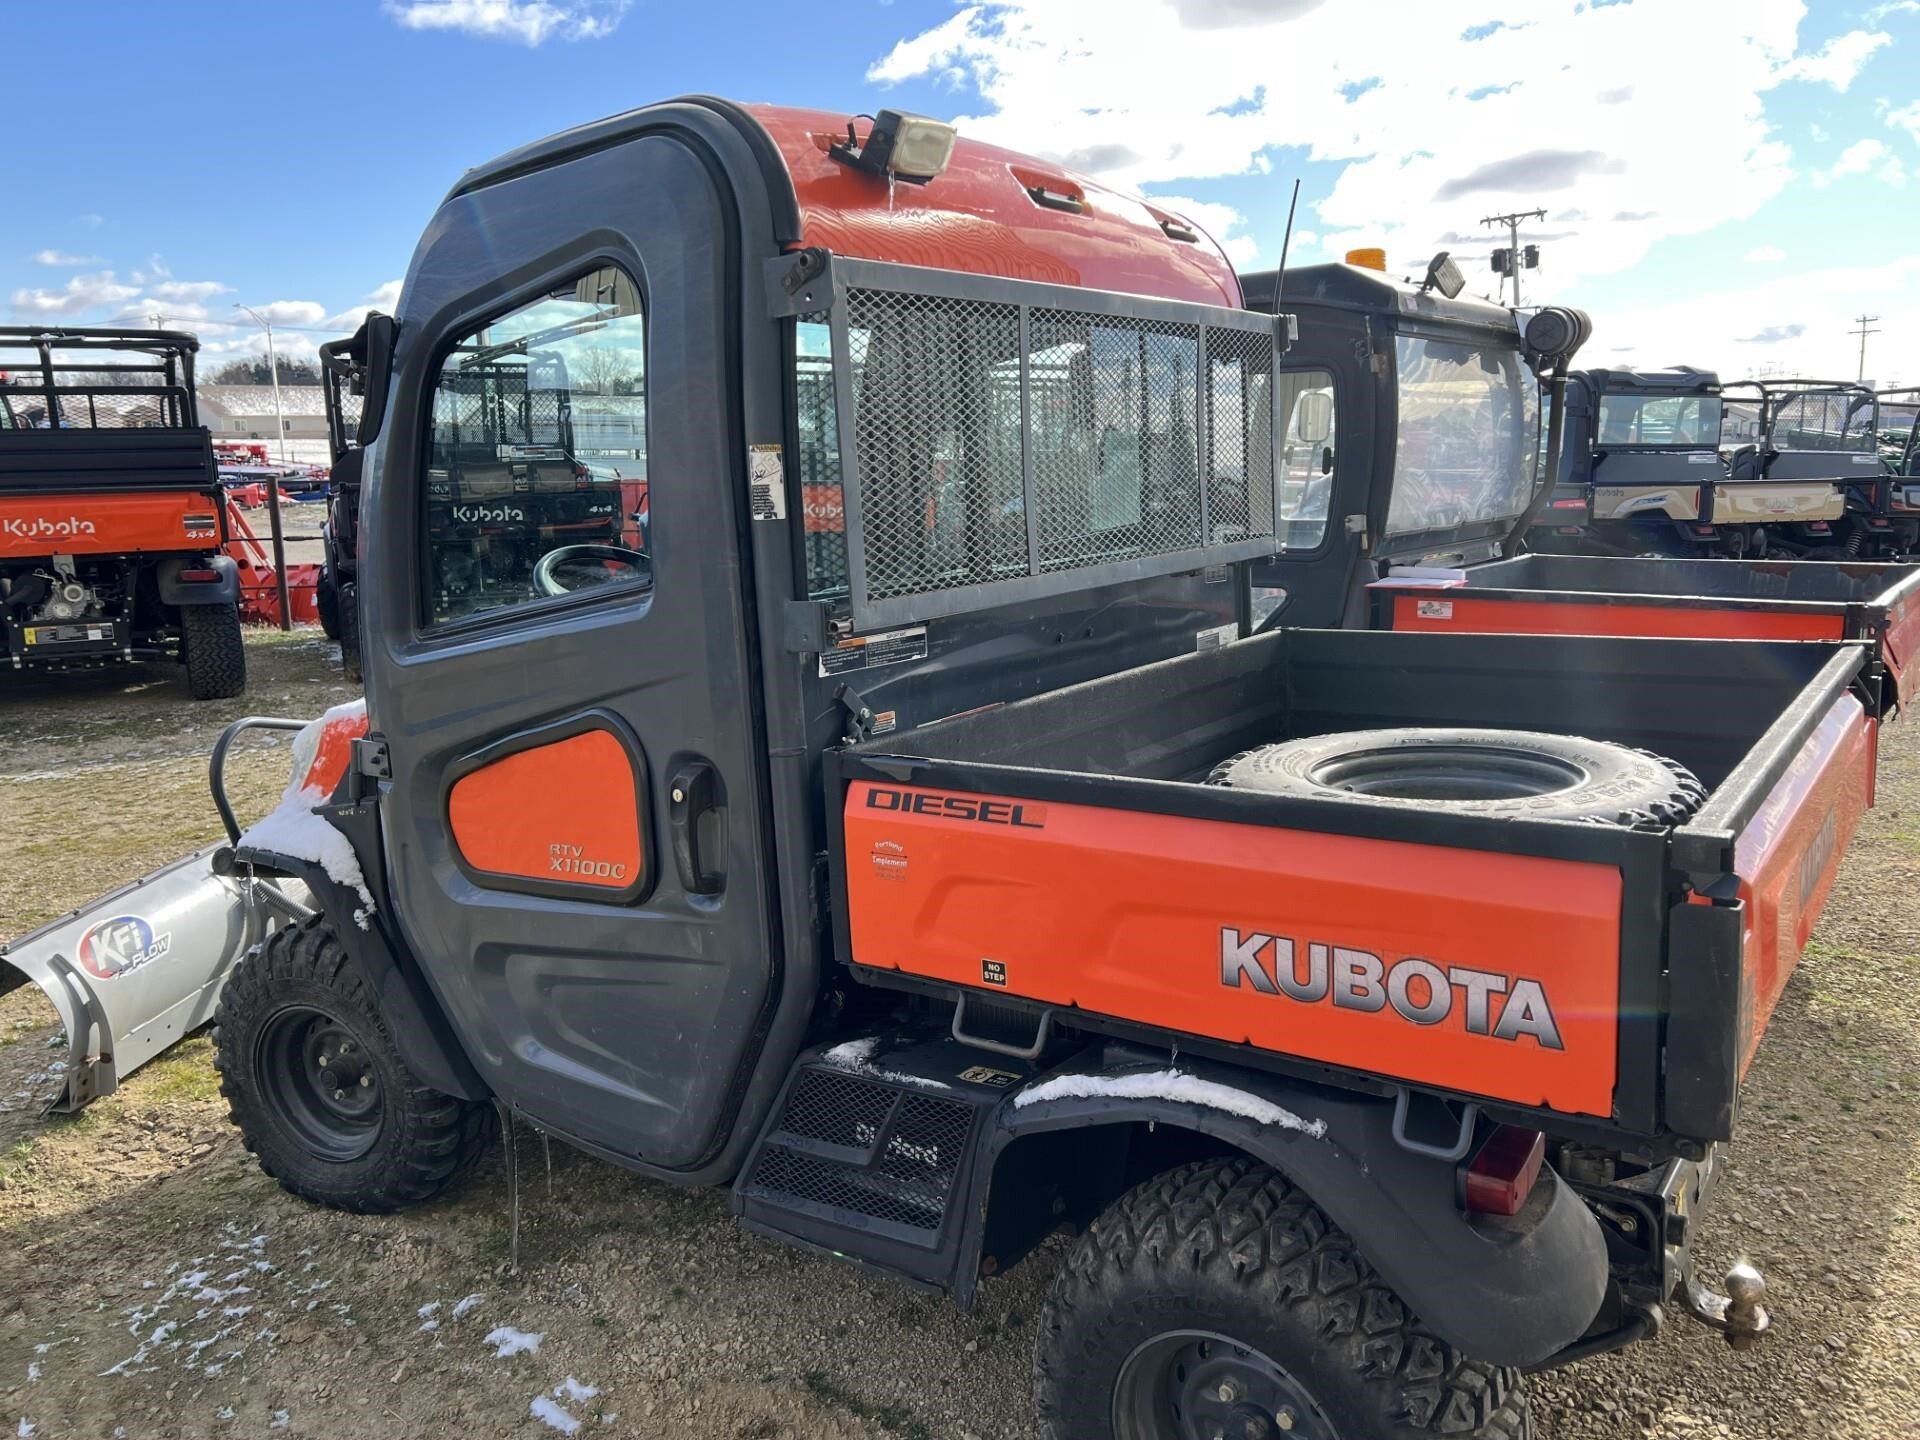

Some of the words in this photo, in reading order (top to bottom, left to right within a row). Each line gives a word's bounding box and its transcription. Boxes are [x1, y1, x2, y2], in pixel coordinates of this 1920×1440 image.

[453, 505, 524, 522] Kubota
[3, 516, 96, 537] Kubota
[186, 529, 216, 539] 4x4
[866, 788, 1045, 828] DIESEL
[549, 844, 584, 857] RTV
[549, 857, 626, 880] X1100C
[871, 855, 908, 867] Implement
[132, 936, 169, 967] PLOW
[988, 963, 1001, 972] NO
[984, 971, 1005, 982] STEP
[1220, 926, 1565, 1051] KUBOTA
